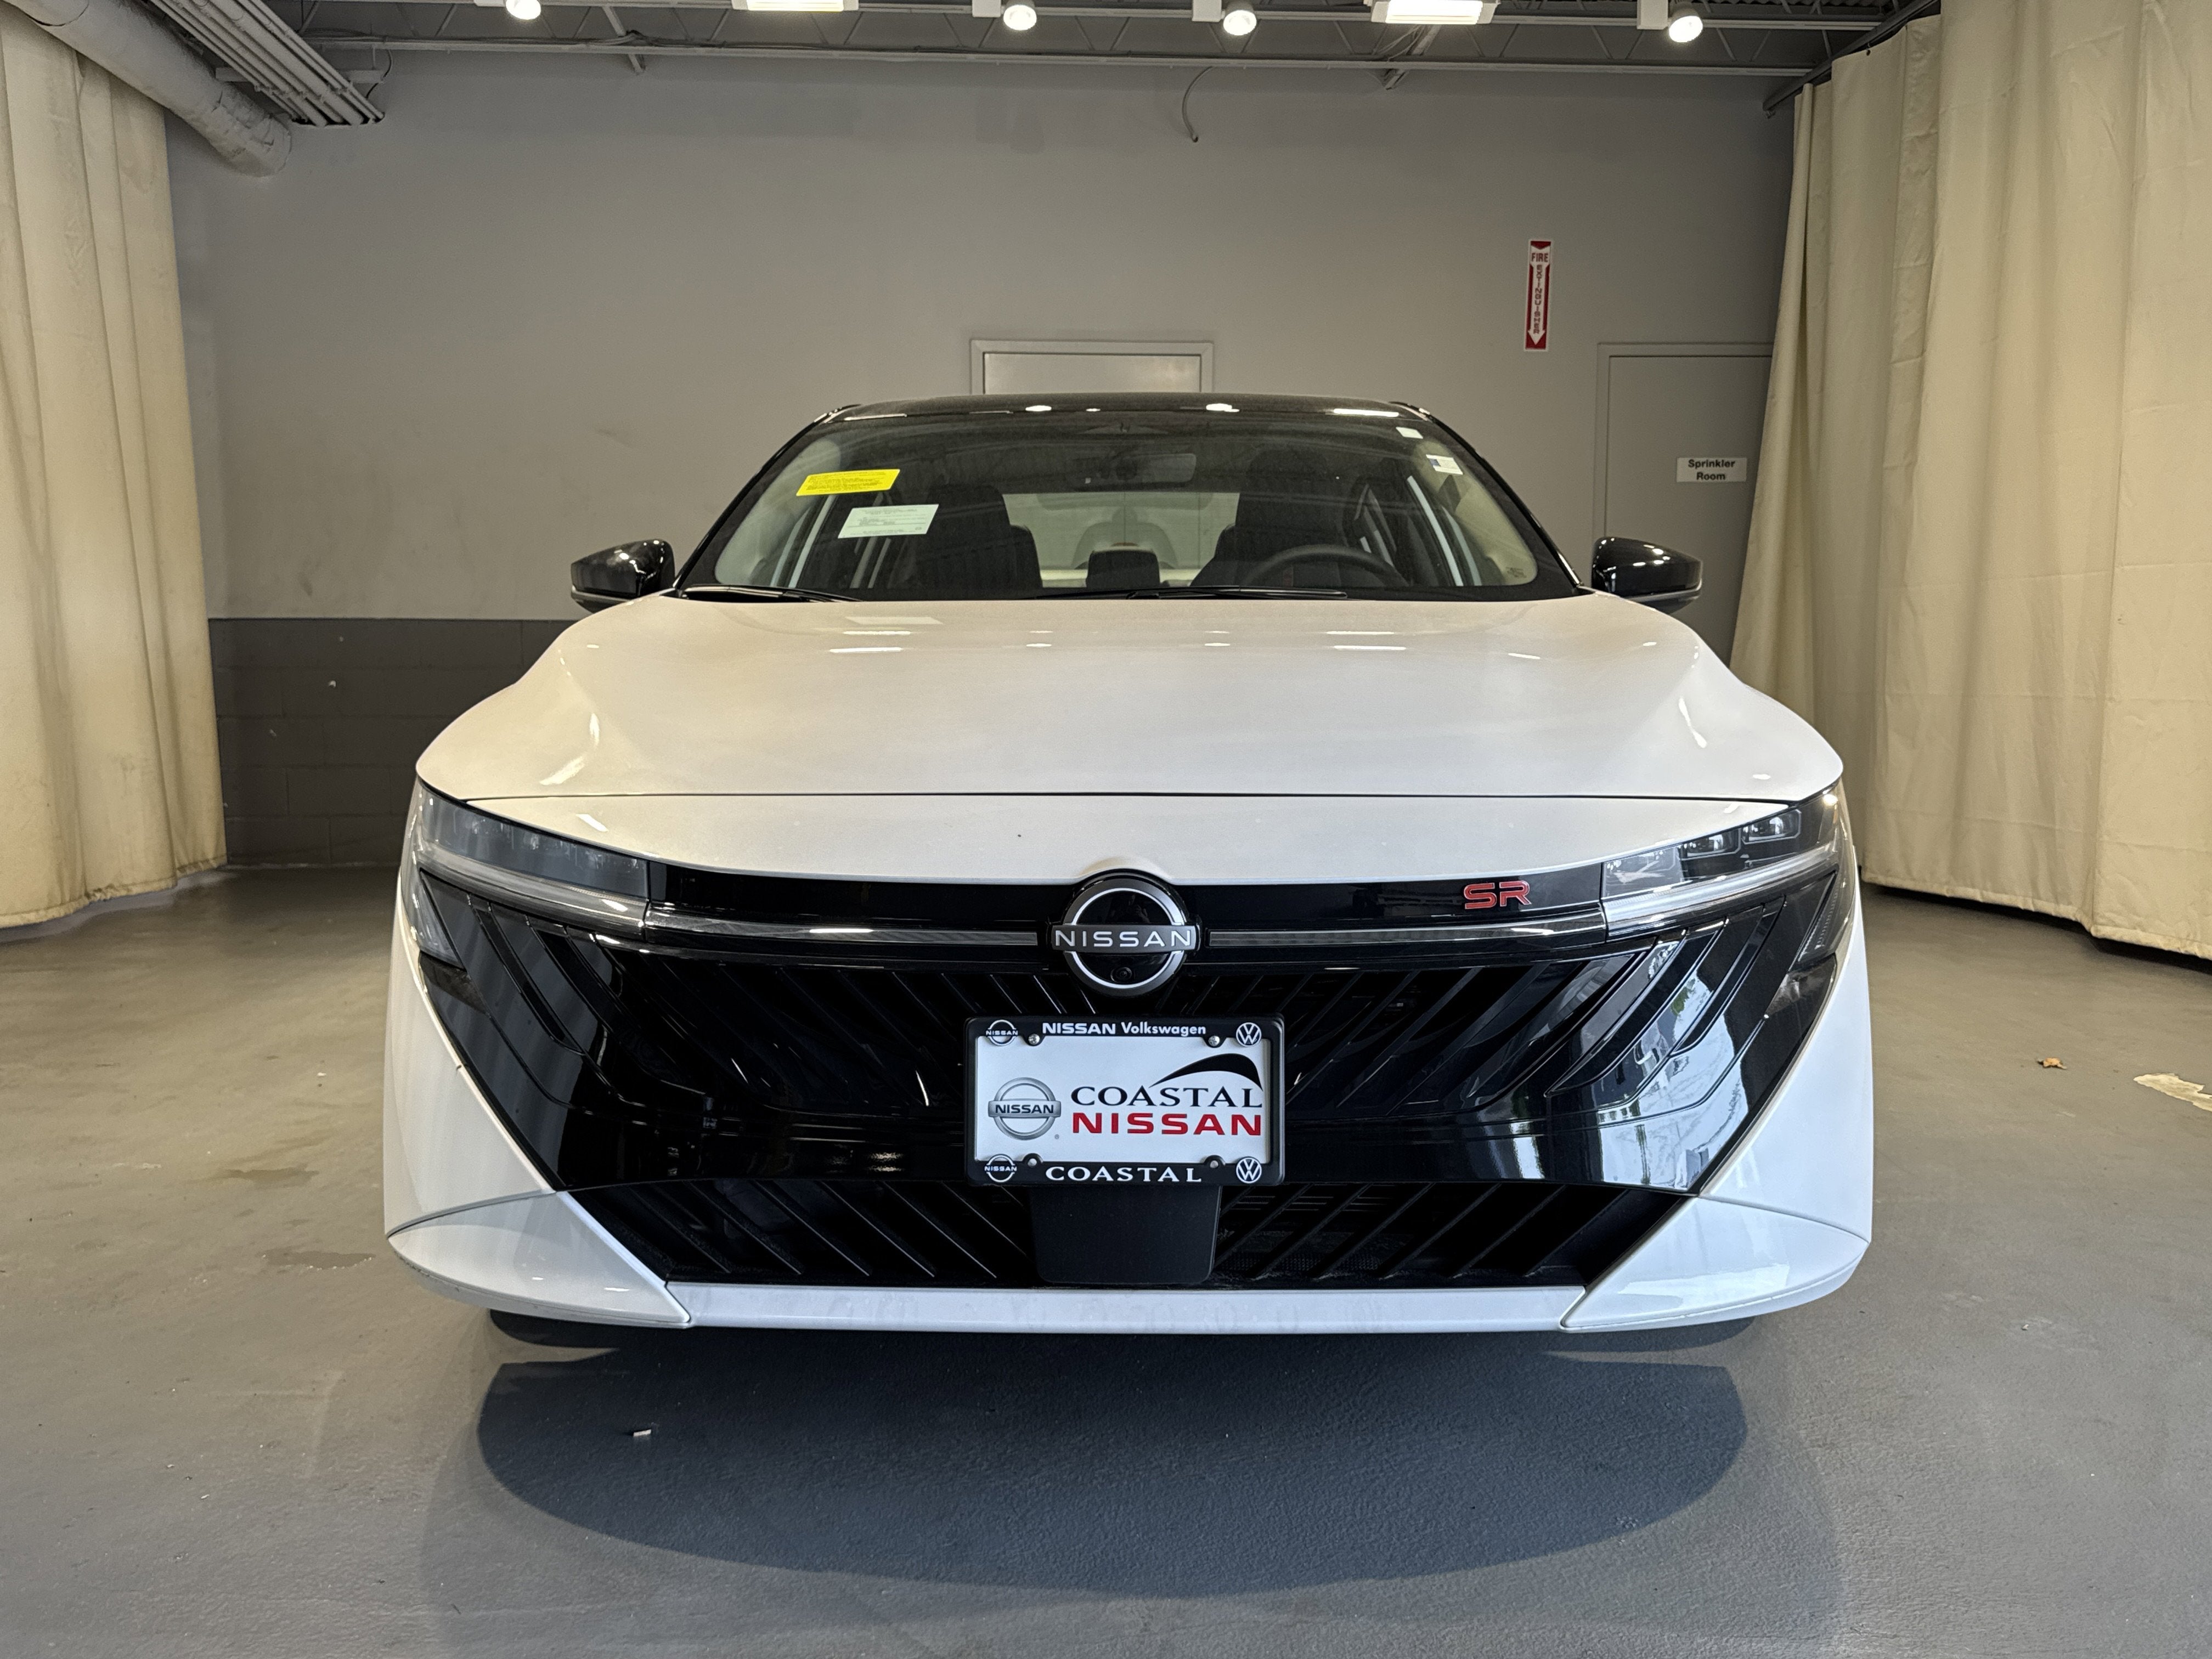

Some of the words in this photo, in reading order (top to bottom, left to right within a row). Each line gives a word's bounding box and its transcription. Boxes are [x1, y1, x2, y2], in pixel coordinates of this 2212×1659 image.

[1531, 253, 1548, 262] FIRE
[1533, 264, 1542, 334] EXTINGUISHER
[1688, 459, 1735, 469] Sprinkler
[1696, 472, 1725, 480] Room
[1464, 880, 1532, 910] SR
[1055, 930, 1191, 947] NISSAN
[1043, 1023, 1116, 1034] NISSAN
[1122, 1022, 1206, 1036] Volkswagen
[1071, 1085, 1262, 1108] COASTAL
[995, 1103, 1054, 1114] NISSAN
[1073, 1113, 1261, 1136] NISSAN
[1046, 1166, 1202, 1182] COASTAL
